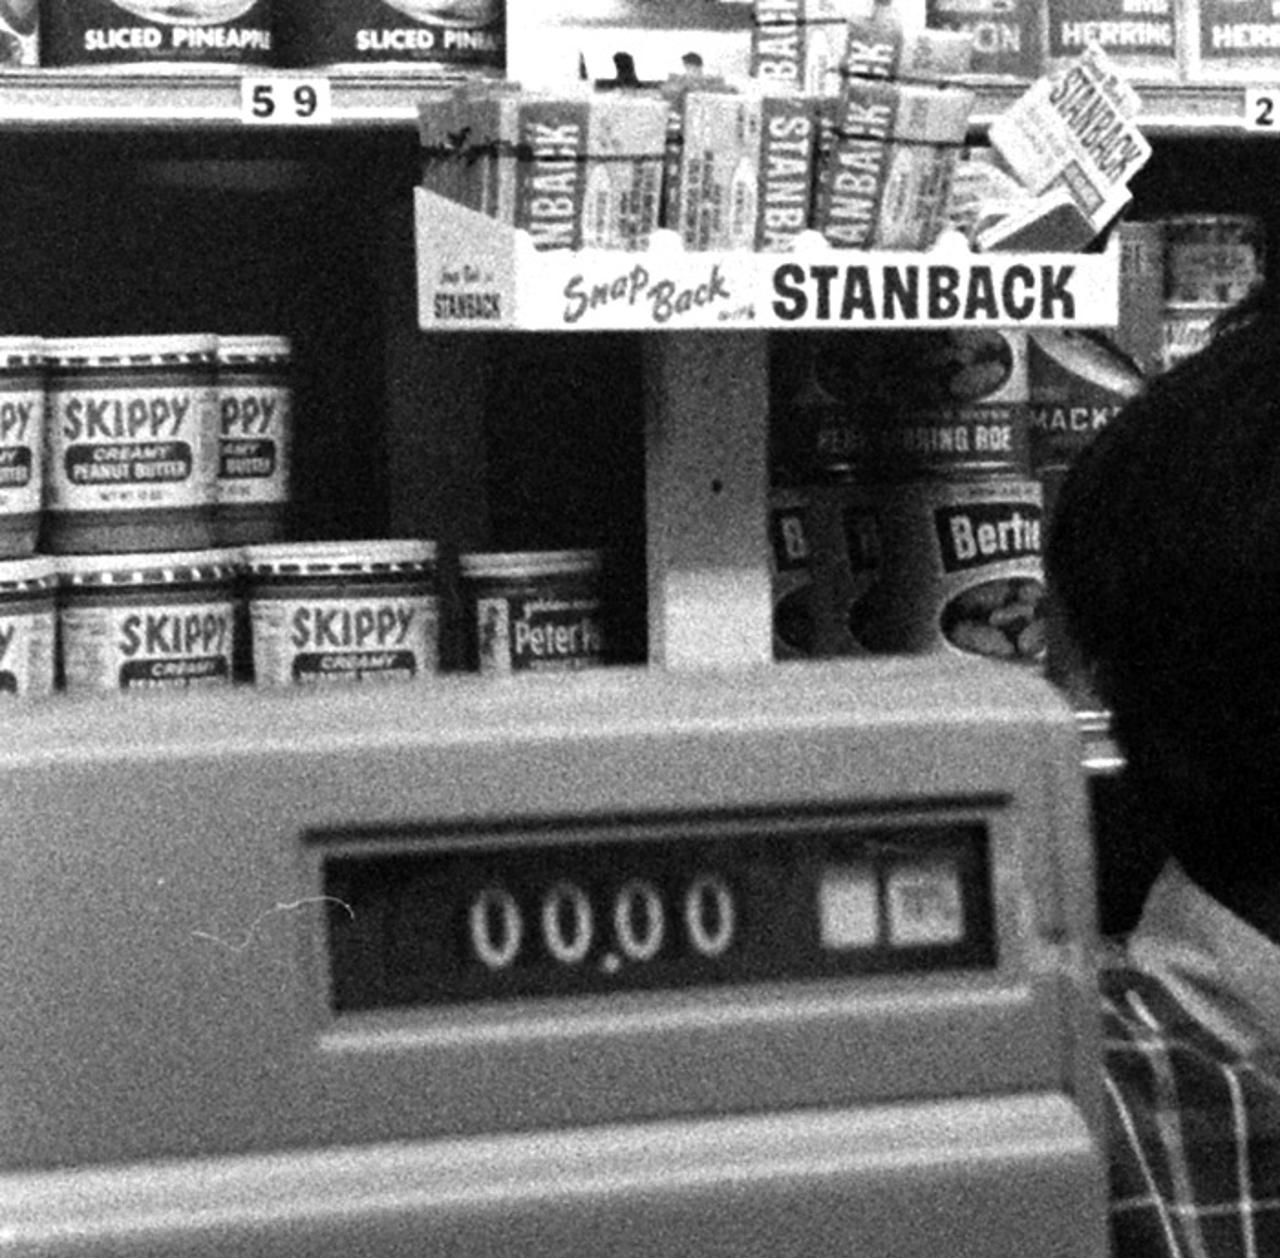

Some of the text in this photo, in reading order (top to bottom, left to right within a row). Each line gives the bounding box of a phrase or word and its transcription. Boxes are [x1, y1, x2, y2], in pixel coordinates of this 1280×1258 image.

[84, 28, 162, 50] SLICED
[356, 28, 434, 51] SLICED
[252, 85, 318, 117] 59
[562, 263, 650, 324] Snap
[647, 263, 732, 323] Back
[771, 263, 1076, 321] STANBACK
[63, 397, 192, 441] SKIPPY
[290, 606, 416, 649] SKIPPY
[514, 618, 578, 656] Peter
